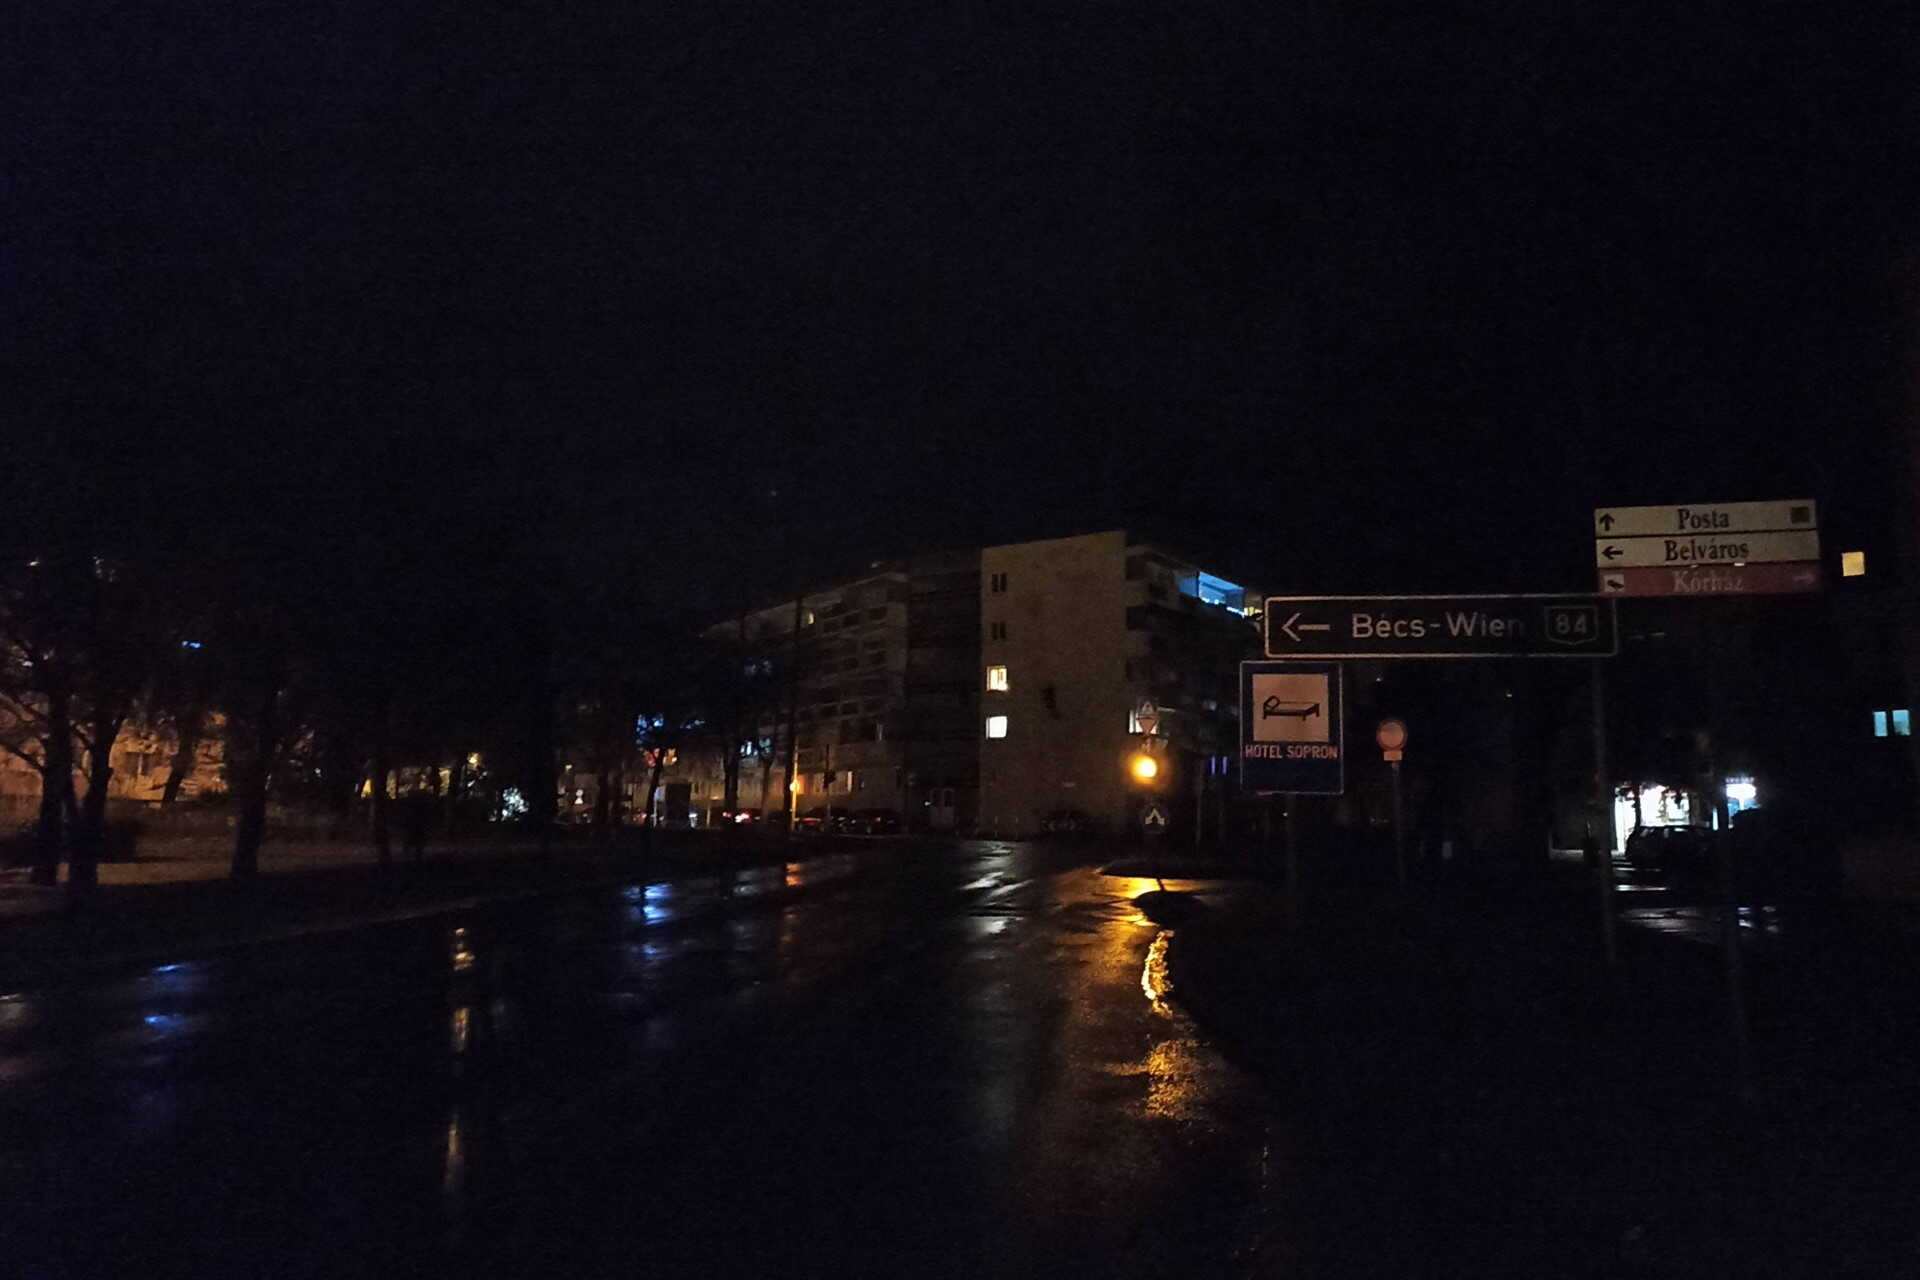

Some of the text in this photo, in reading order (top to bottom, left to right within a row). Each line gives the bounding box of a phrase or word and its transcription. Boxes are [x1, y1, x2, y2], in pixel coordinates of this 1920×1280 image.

[1677, 508, 1730, 530] Posta
[1664, 538, 1749, 561] Belváros
[1351, 611, 1587, 639] Bécs-Wien 84
[1245, 745, 1338, 759] HOTEL SOPRON
